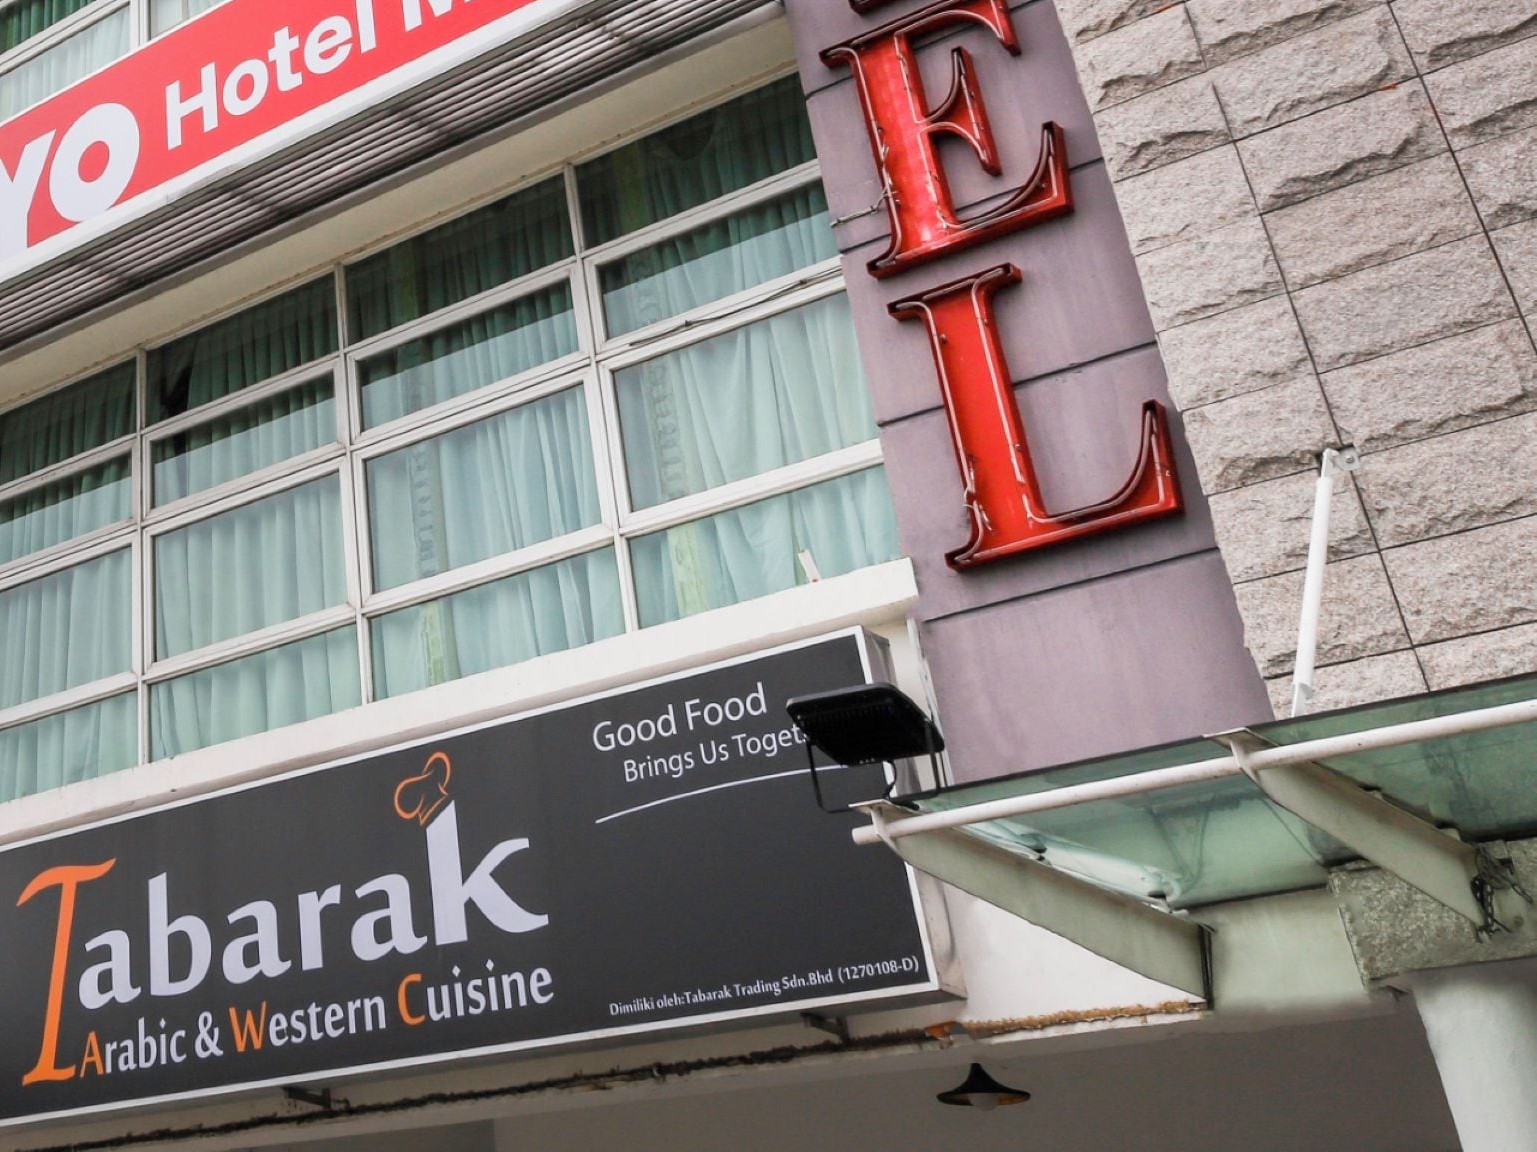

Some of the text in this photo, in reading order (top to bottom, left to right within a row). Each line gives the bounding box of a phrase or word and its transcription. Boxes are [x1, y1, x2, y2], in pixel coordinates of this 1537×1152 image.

[592, 681, 768, 752] Good Food
[623, 723, 808, 783] Brings Us Toget
[16, 800, 550, 1086] Tabarak
[79, 957, 555, 1079] Arabic & Western Cuisine
[609, 997, 655, 1017] Dimiliki
[733, 975, 782, 997] Trading
[781, 968, 834, 990] Sdn.Bhd
[838, 954, 920, 984] (1270108-D)
